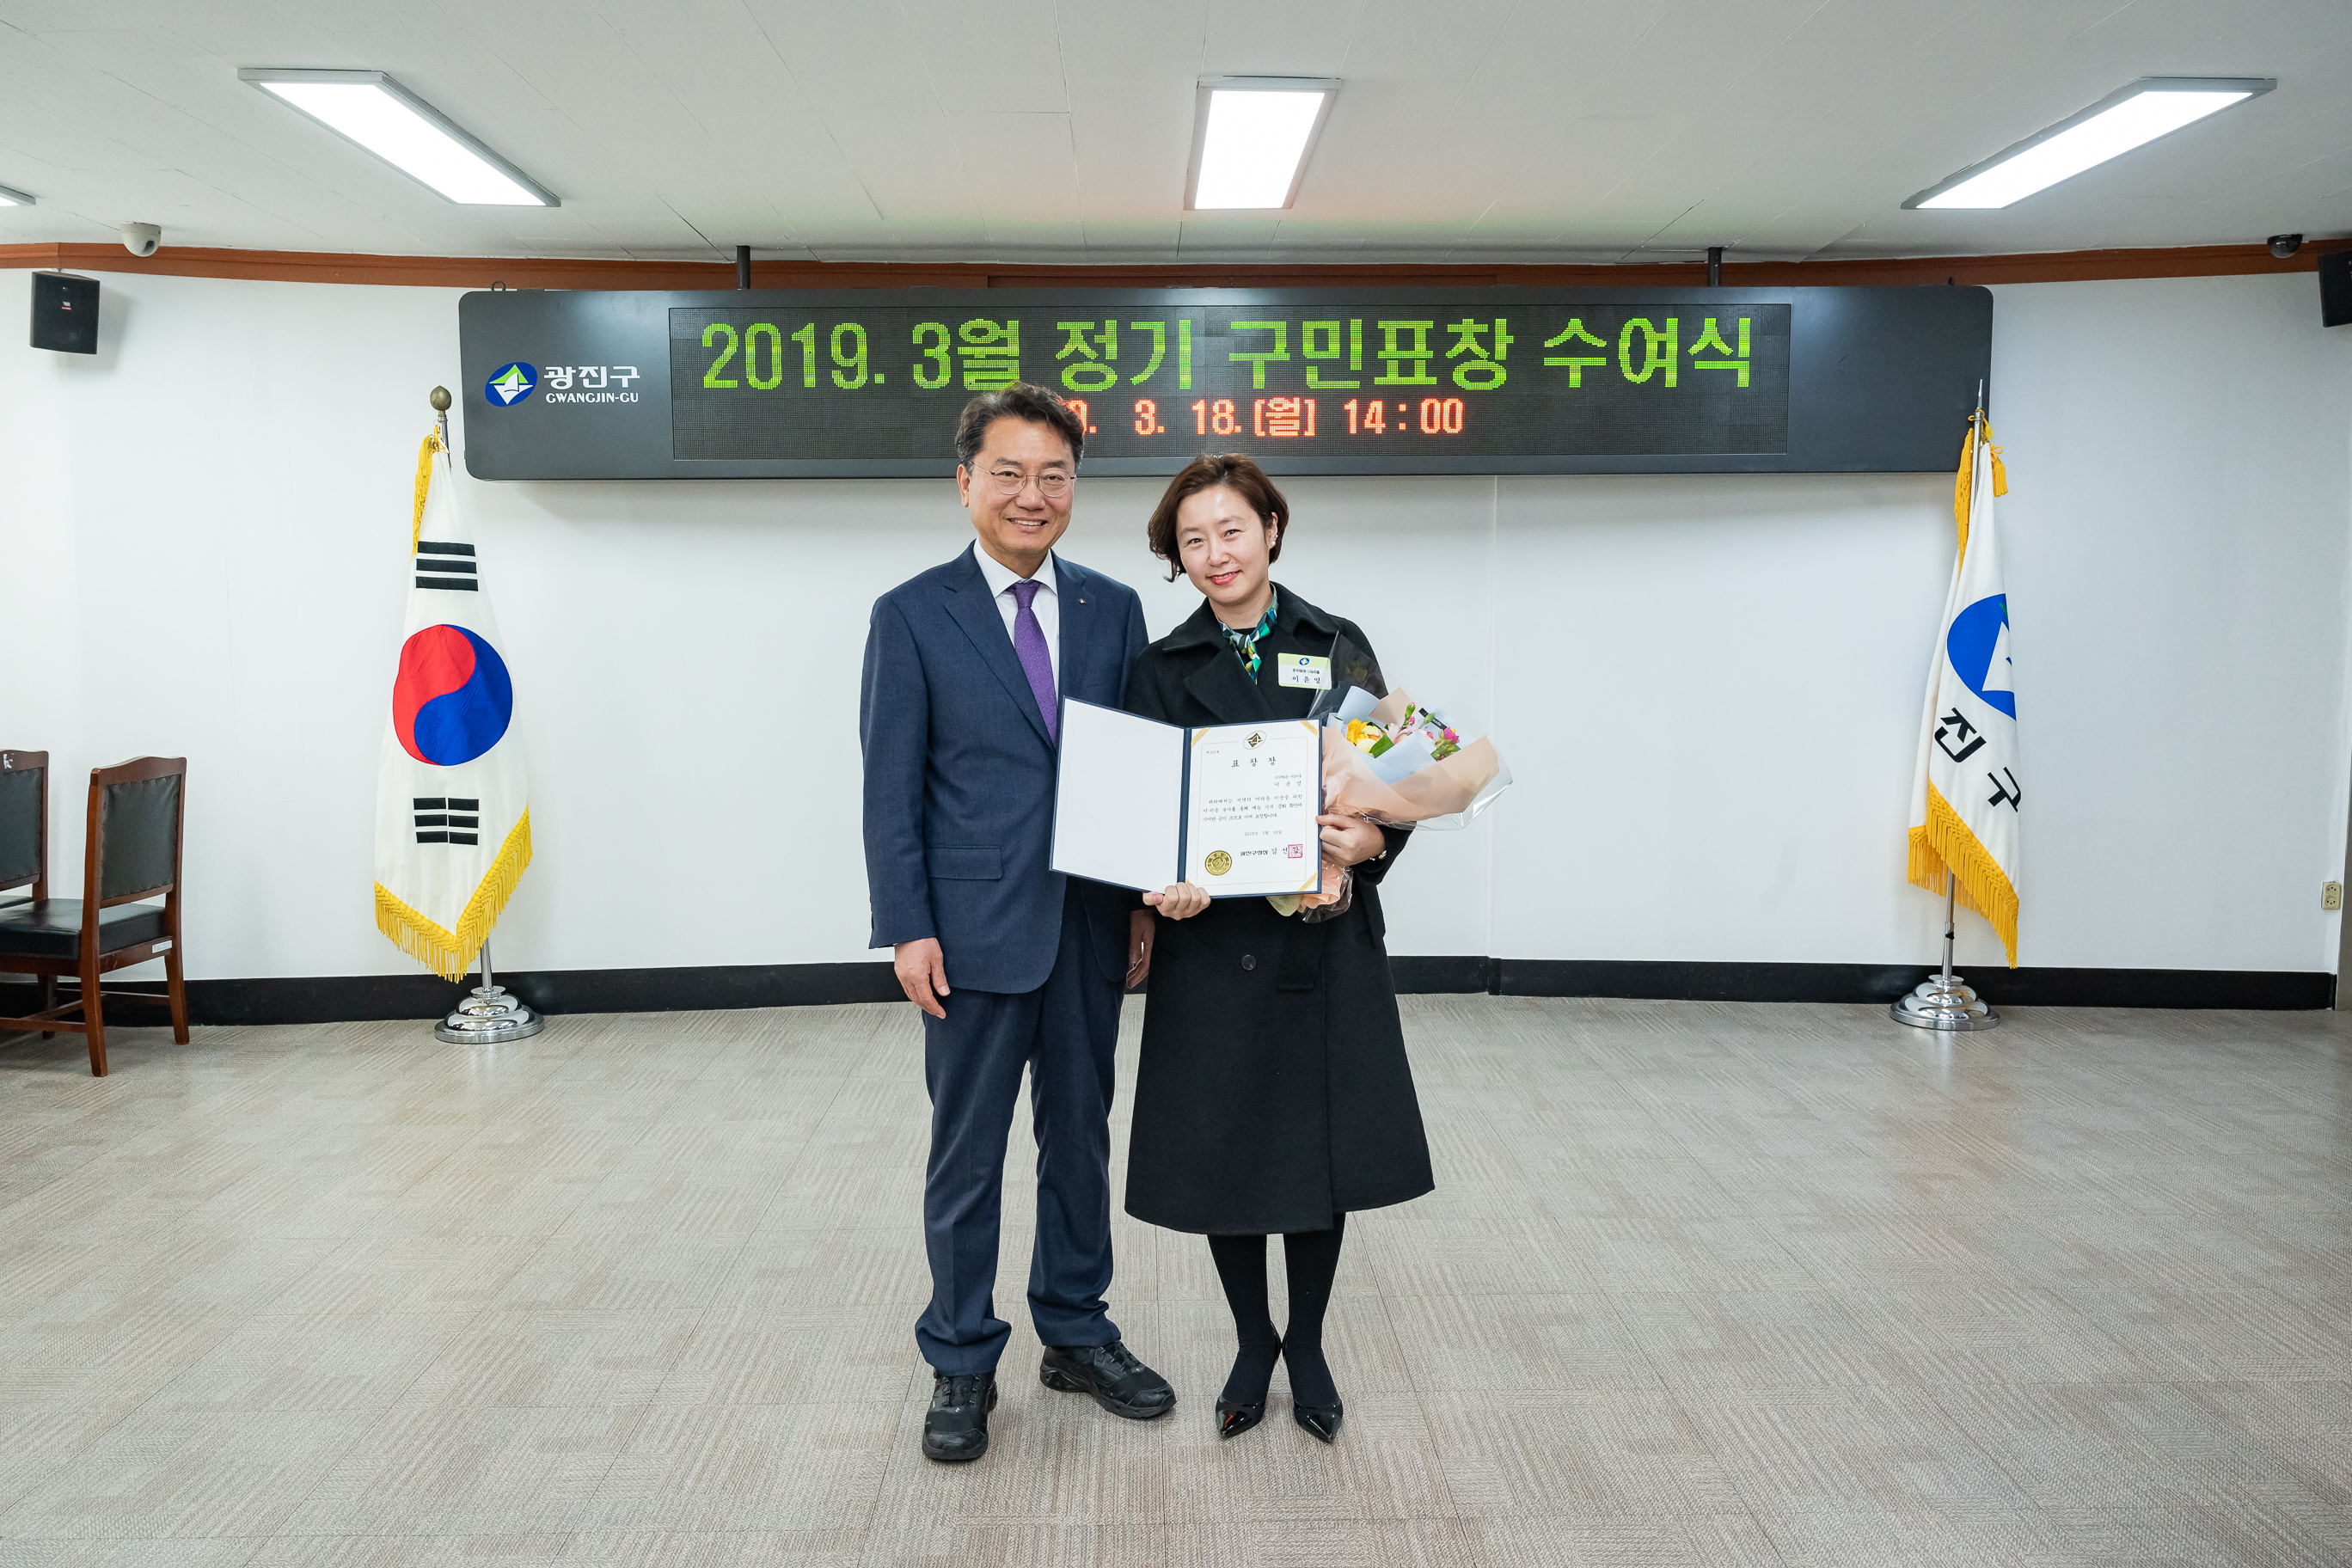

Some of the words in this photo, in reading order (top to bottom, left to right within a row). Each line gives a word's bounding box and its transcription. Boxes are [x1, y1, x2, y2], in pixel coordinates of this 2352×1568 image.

[701, 322, 885, 390] 2019.
[912, 319, 1020, 391] 3월
[1056, 319, 1191, 392] 정기
[1228, 318, 1516, 391] 구민표창
[1543, 317, 1752, 389] 수여식
[543, 365, 640, 390] 광진구
[545, 392, 639, 404] GWANGJIN-GU
[1134, 398, 1166, 436] 3.
